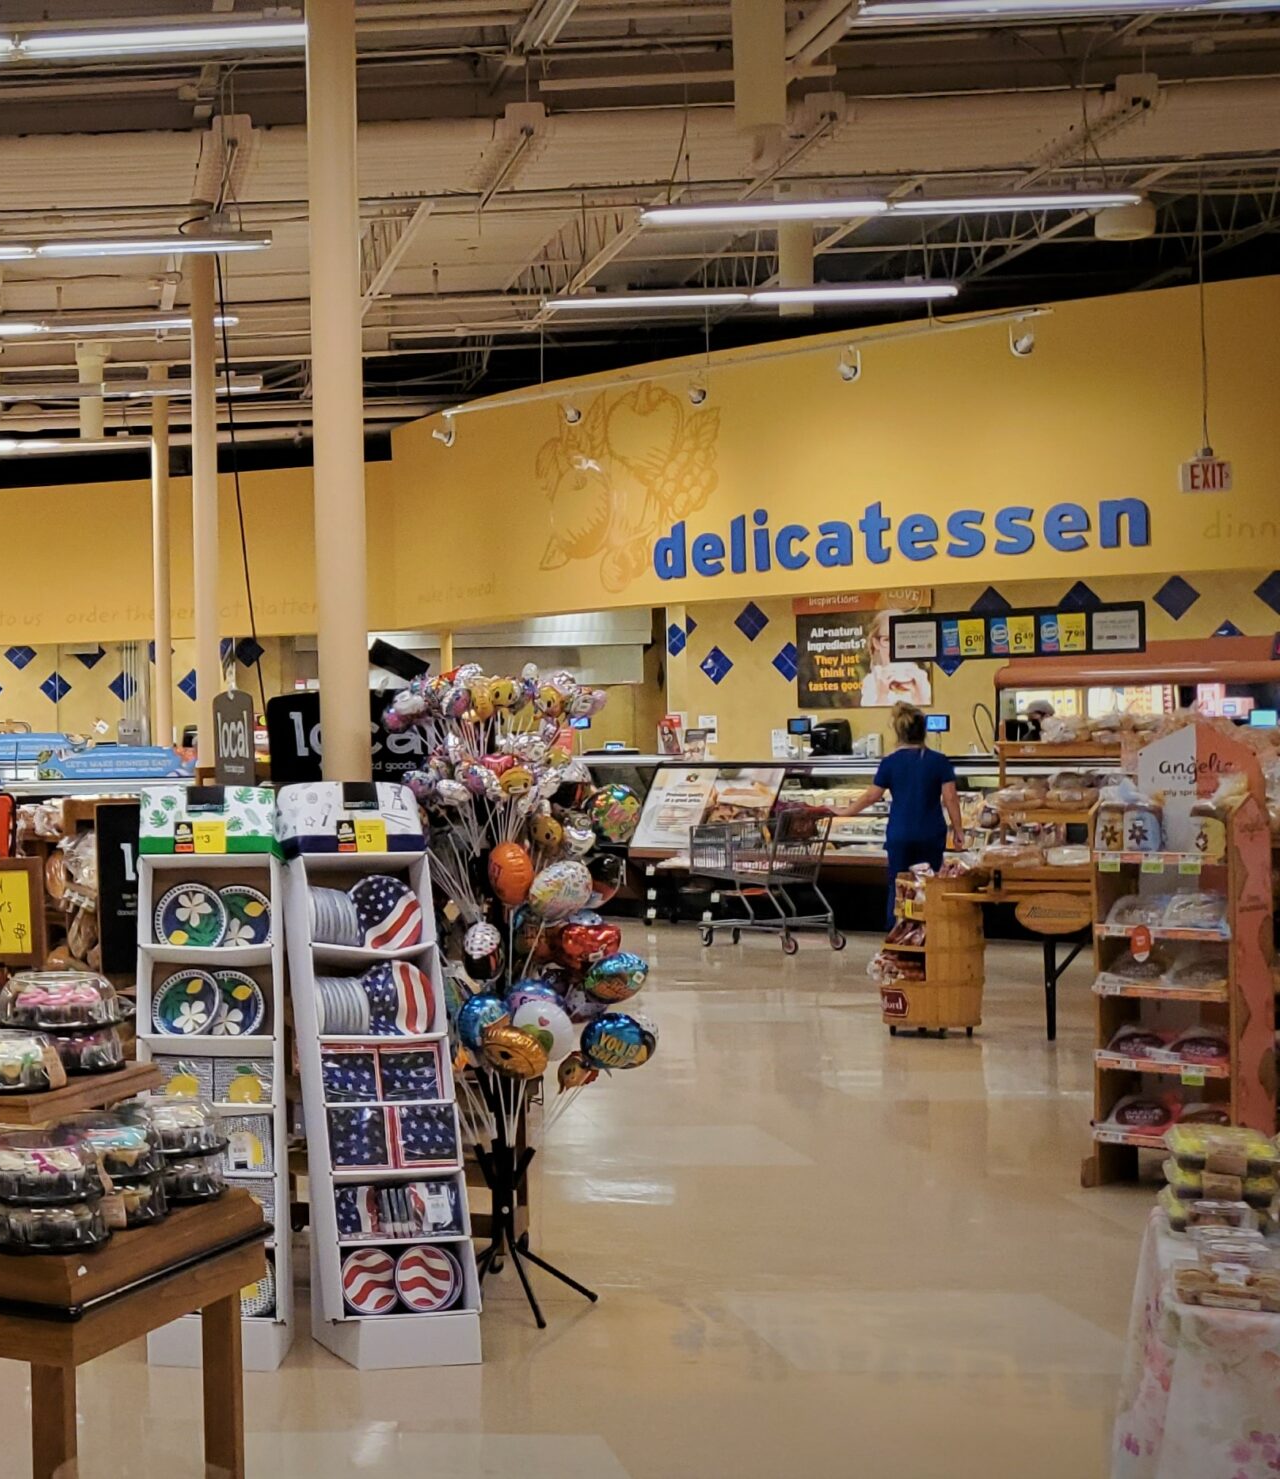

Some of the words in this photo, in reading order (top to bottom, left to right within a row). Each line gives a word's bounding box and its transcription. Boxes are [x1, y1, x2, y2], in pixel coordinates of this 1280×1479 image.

[1191, 463, 1225, 489] EXIT
[653, 496, 1151, 581] delicatessen
[810, 626, 863, 638] All-natural
[815, 655, 839, 666] They
[841, 655, 859, 665] just
[820, 668, 845, 678] think
[847, 667, 856, 677] it
[809, 681, 839, 691] tastes
[217, 710, 249, 758] local
[385, 760, 417, 771] goods
